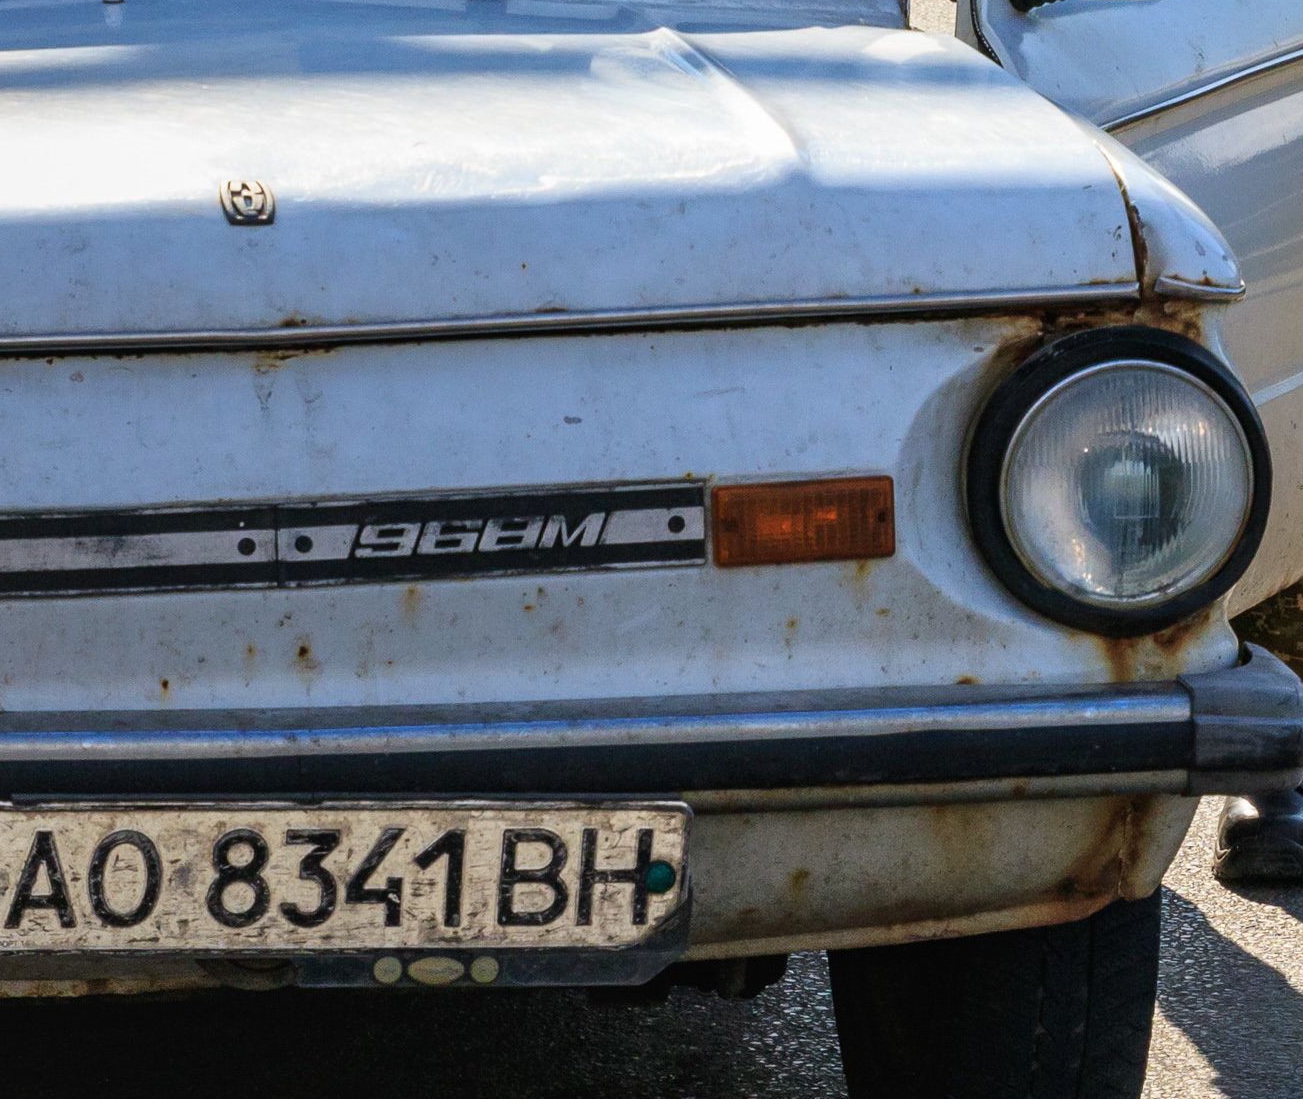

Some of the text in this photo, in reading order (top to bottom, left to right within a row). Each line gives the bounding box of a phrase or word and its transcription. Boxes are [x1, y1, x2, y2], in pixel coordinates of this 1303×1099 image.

[355, 512, 605, 558] 968M
[4, 828, 654, 928] AO 8341 BH
